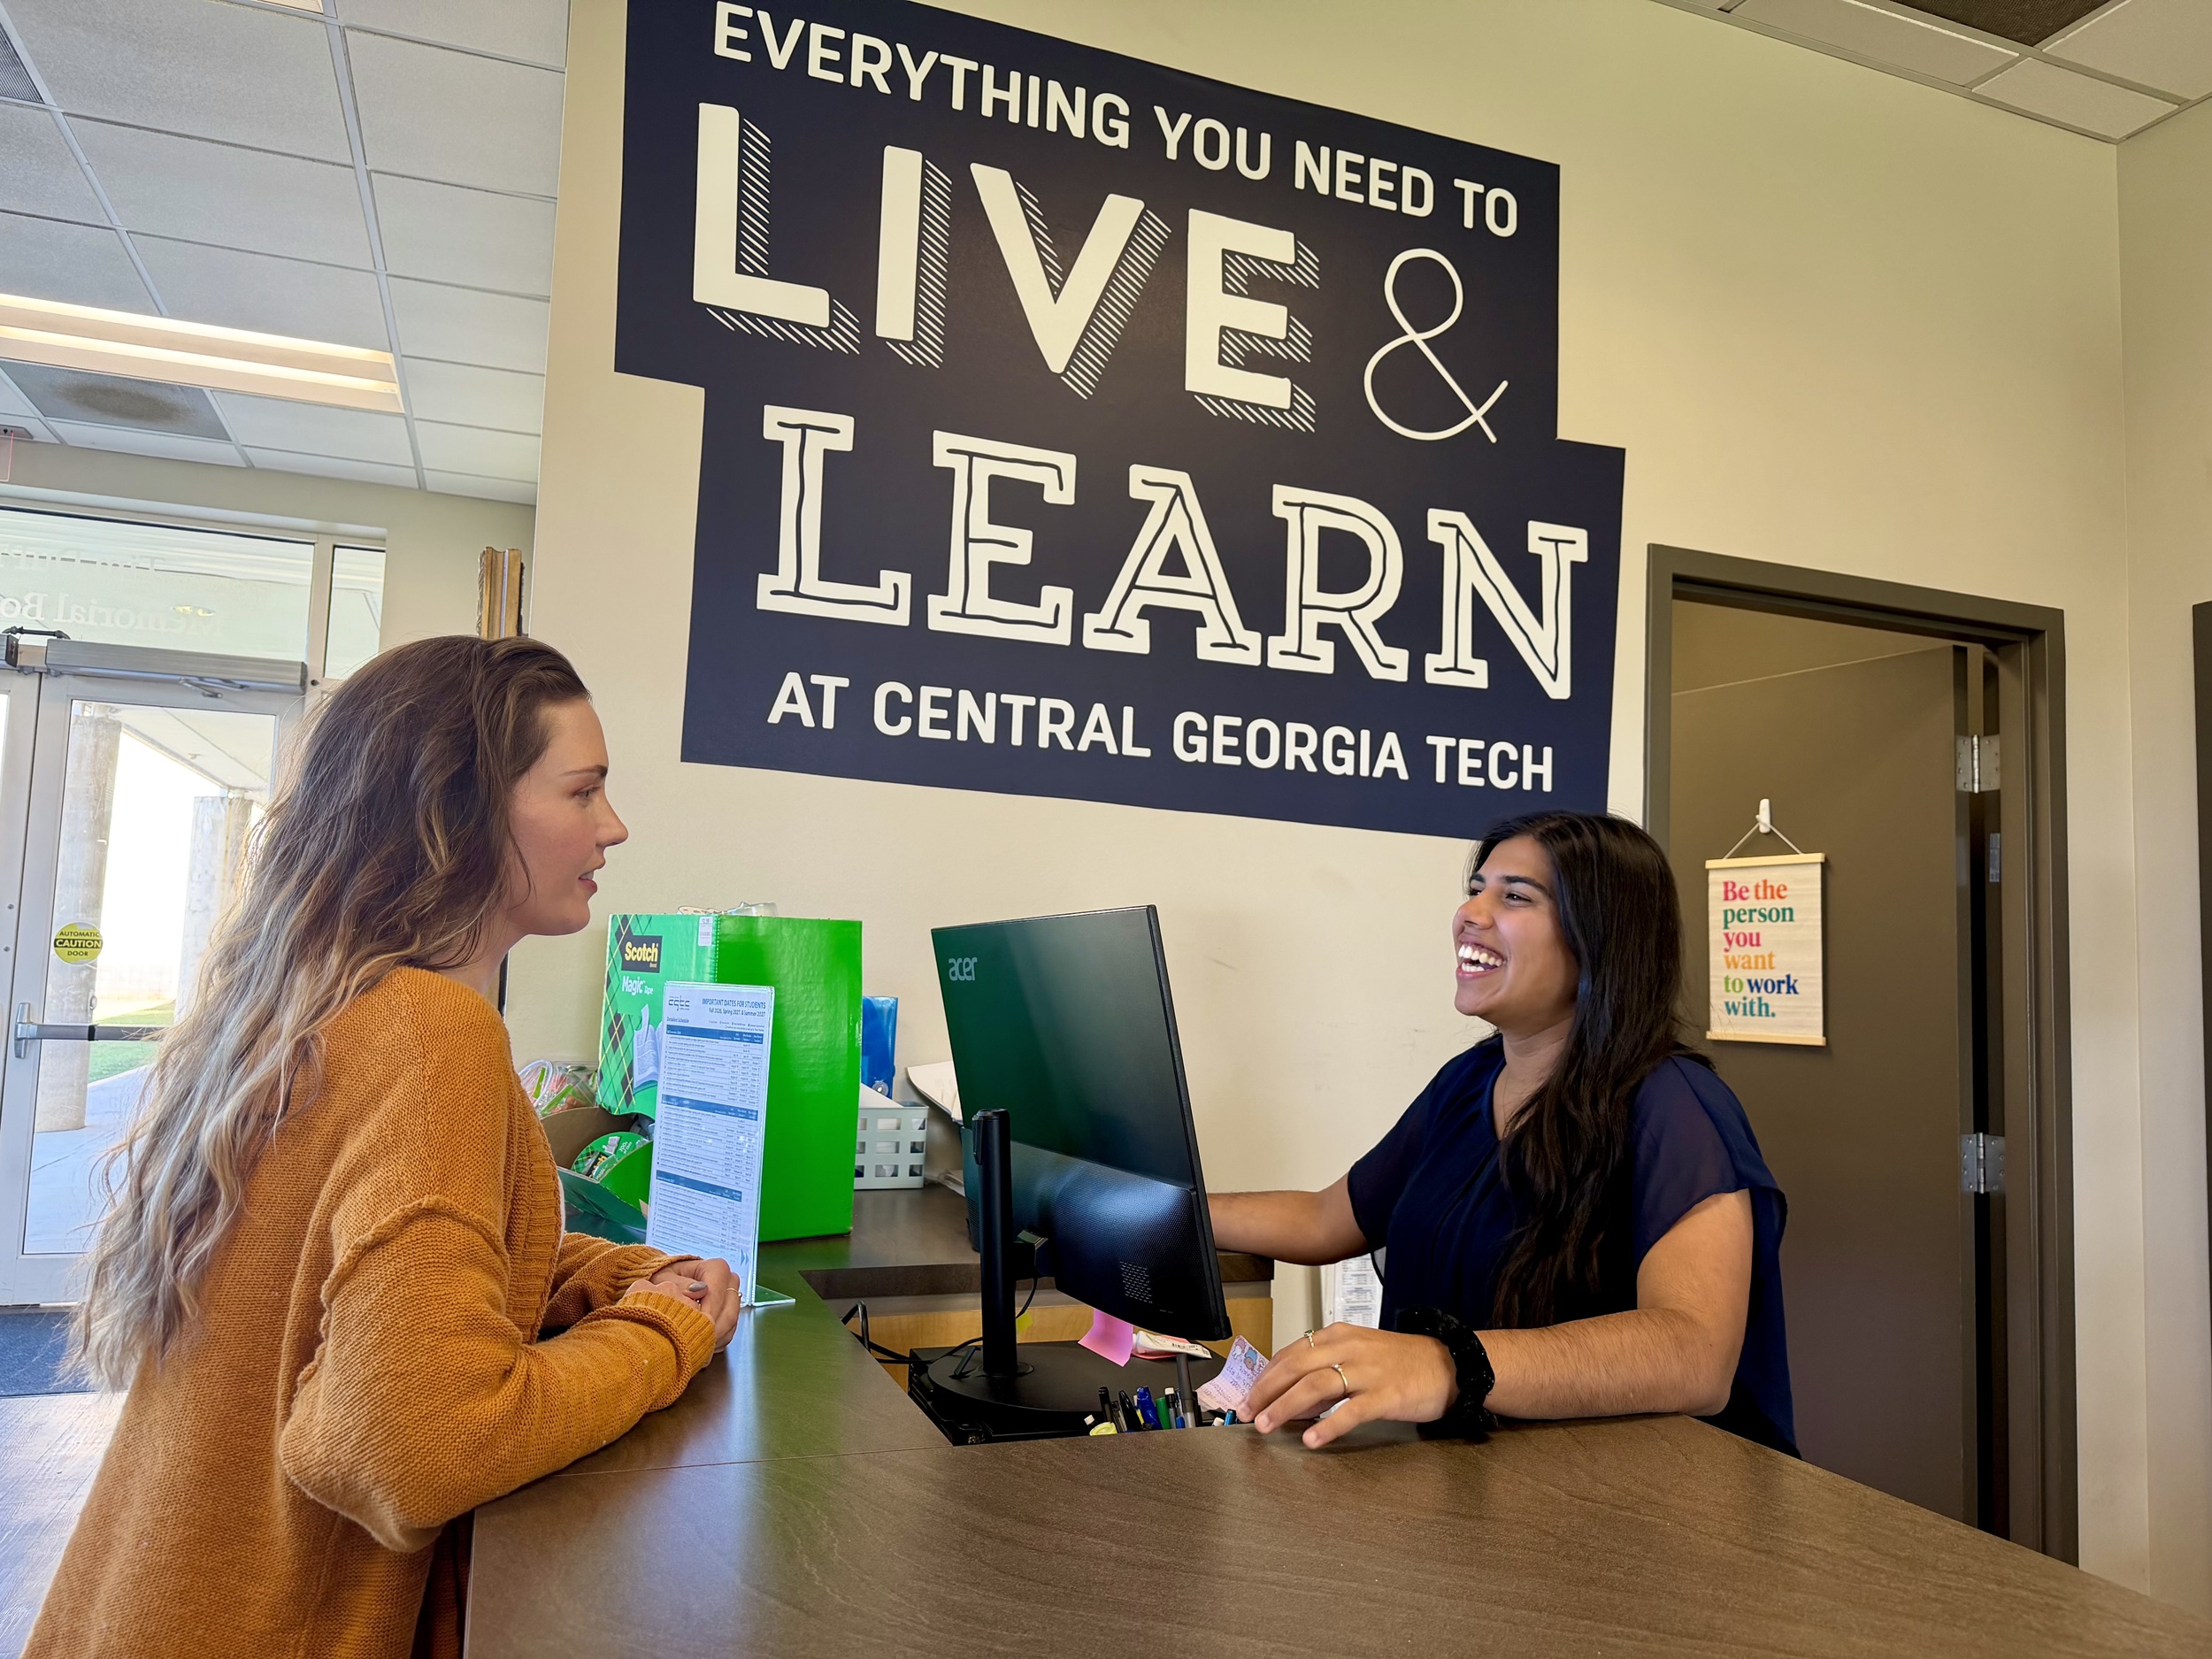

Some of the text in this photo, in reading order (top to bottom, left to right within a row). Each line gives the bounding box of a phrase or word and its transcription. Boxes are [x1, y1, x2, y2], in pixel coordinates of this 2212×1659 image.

[714, 1, 1518, 237] EVERYTHING YOU NEED TO
[693, 103, 1509, 443] LIVE &
[757, 404, 1588, 699] LEARN
[766, 672, 1553, 793] AT CENTRAL GEORGIA TECH
[1723, 879, 1787, 901] Be the
[1723, 906, 1794, 930] person
[56, 939, 102, 948] CAUTION
[625, 941, 658, 962] Scotch
[1724, 931, 1762, 953] you
[949, 956, 978, 981] acer
[1724, 951, 1776, 970] want
[622, 975, 654, 995] Magic Tape
[1724, 974, 1799, 995] to work
[669, 995, 690, 1011] cgtc
[1724, 996, 1776, 1018] with.
